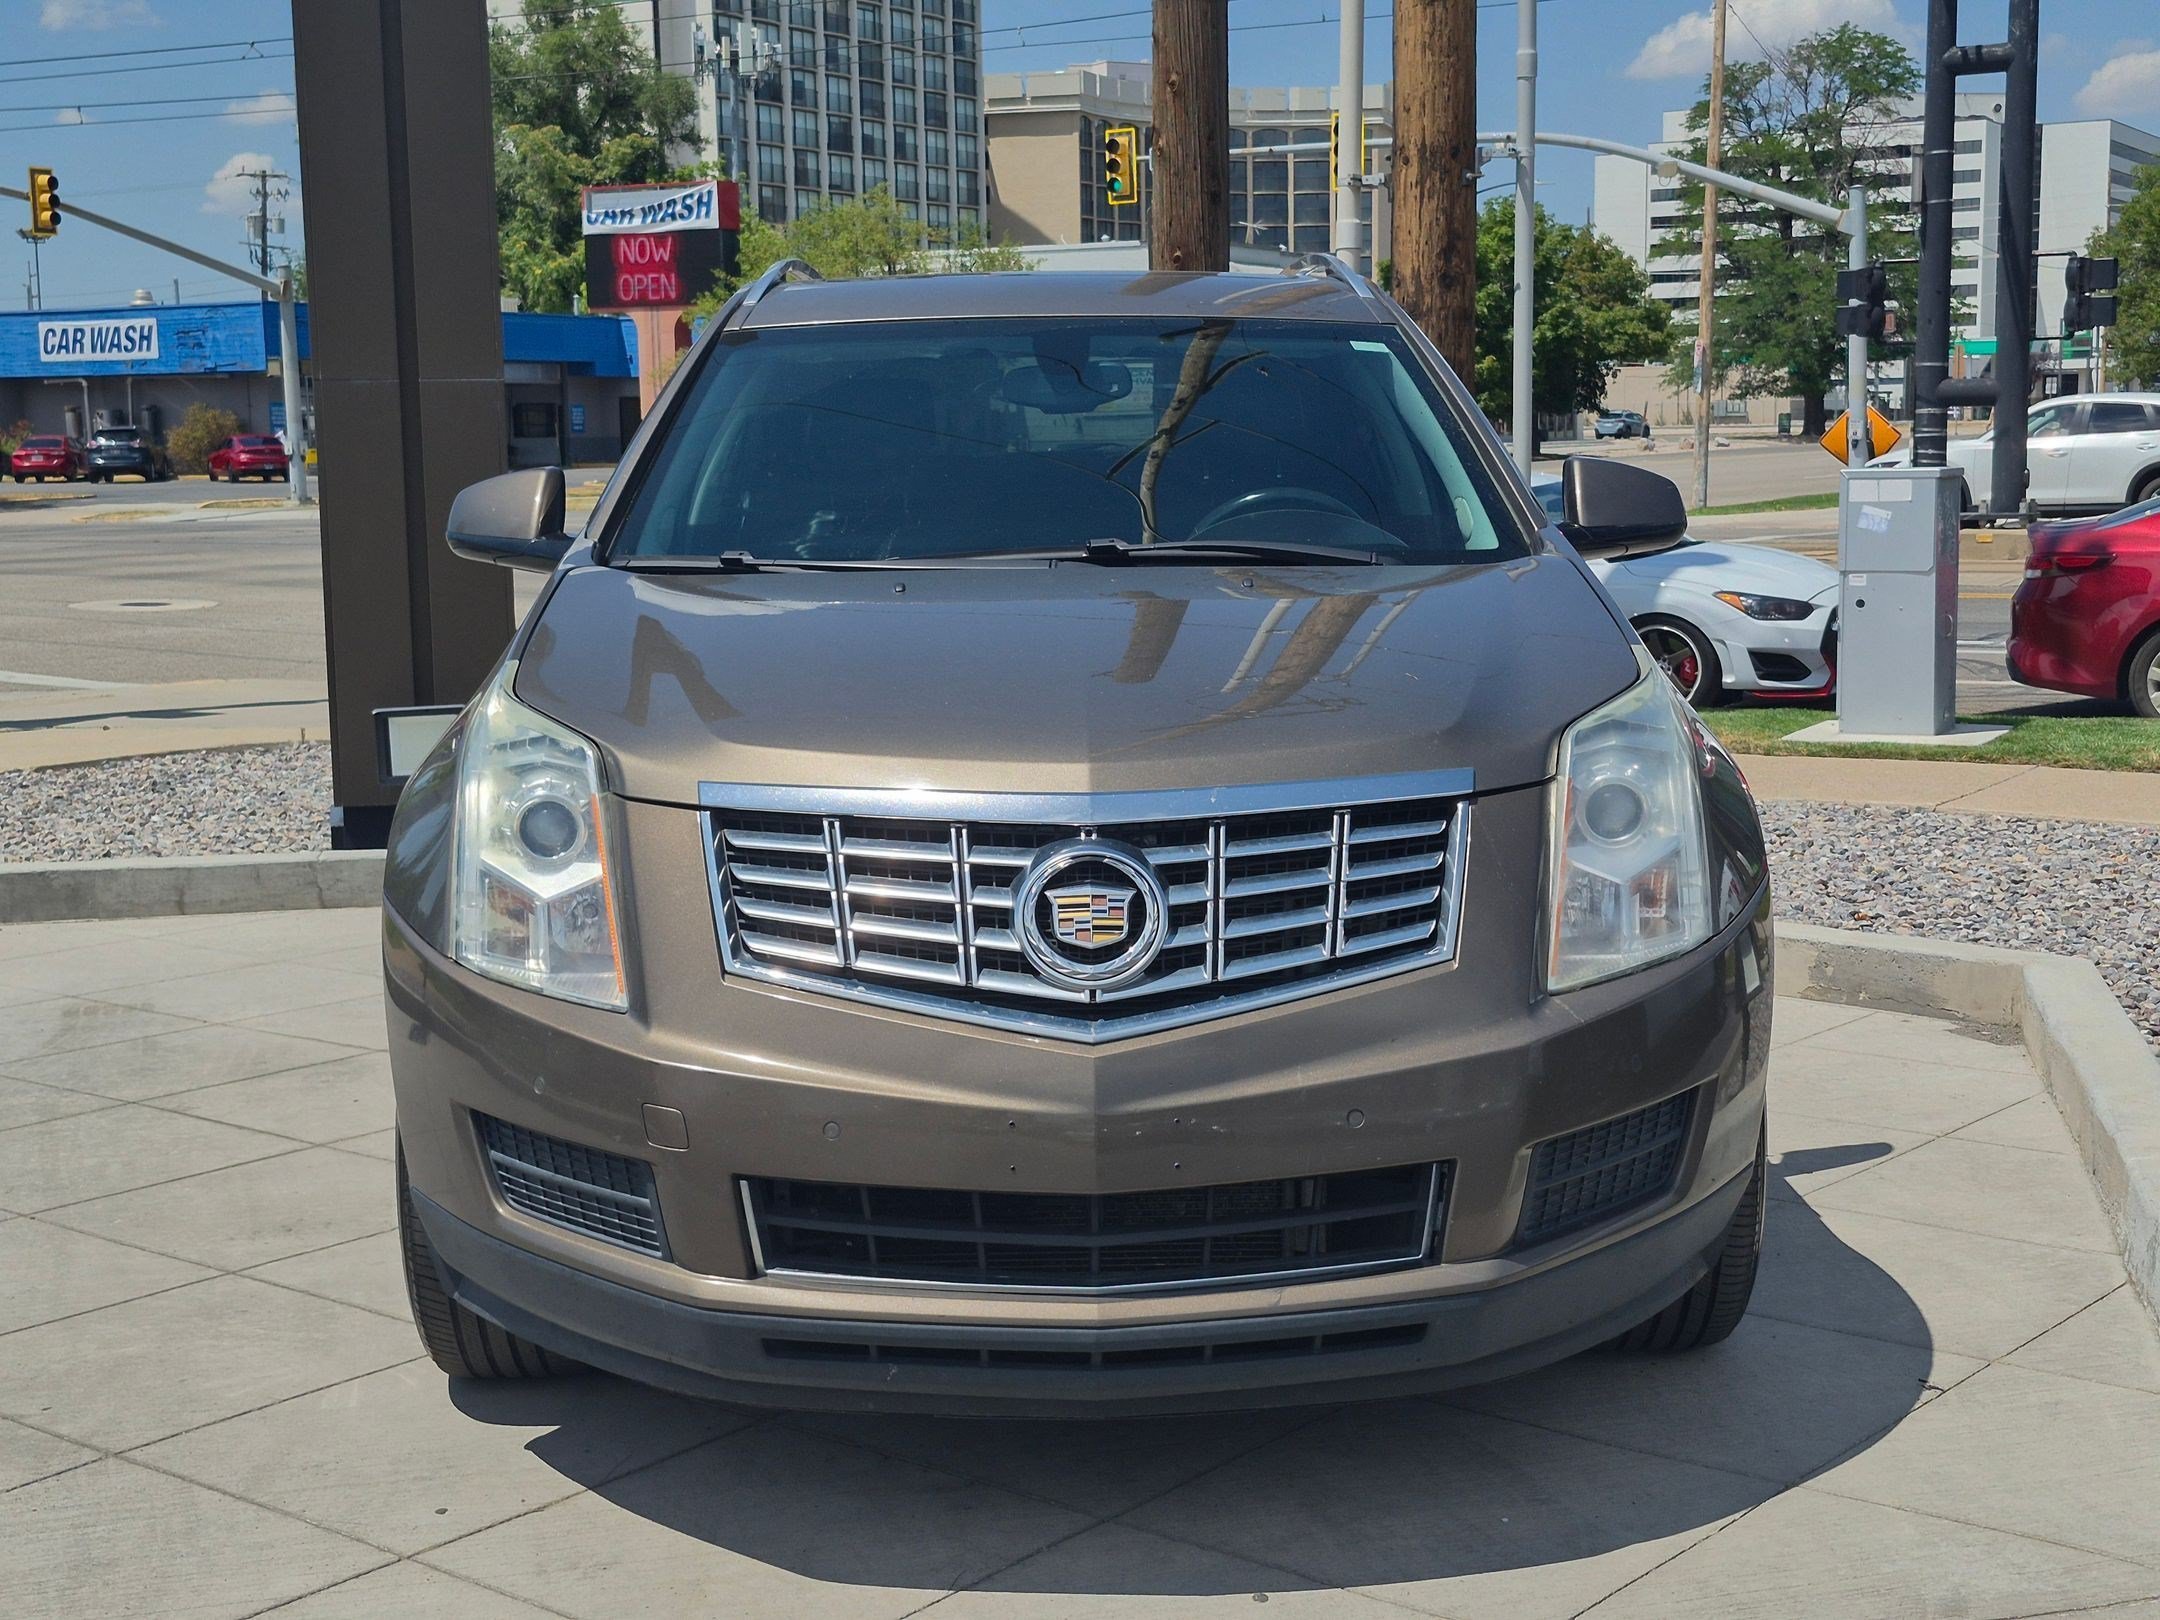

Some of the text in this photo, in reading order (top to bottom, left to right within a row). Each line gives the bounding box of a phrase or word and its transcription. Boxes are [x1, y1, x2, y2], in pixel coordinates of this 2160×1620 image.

[640, 188, 714, 225] WASH
[619, 236, 672, 264] NOW
[618, 272, 677, 301] OPEN
[43, 324, 154, 355] CAR WASH
